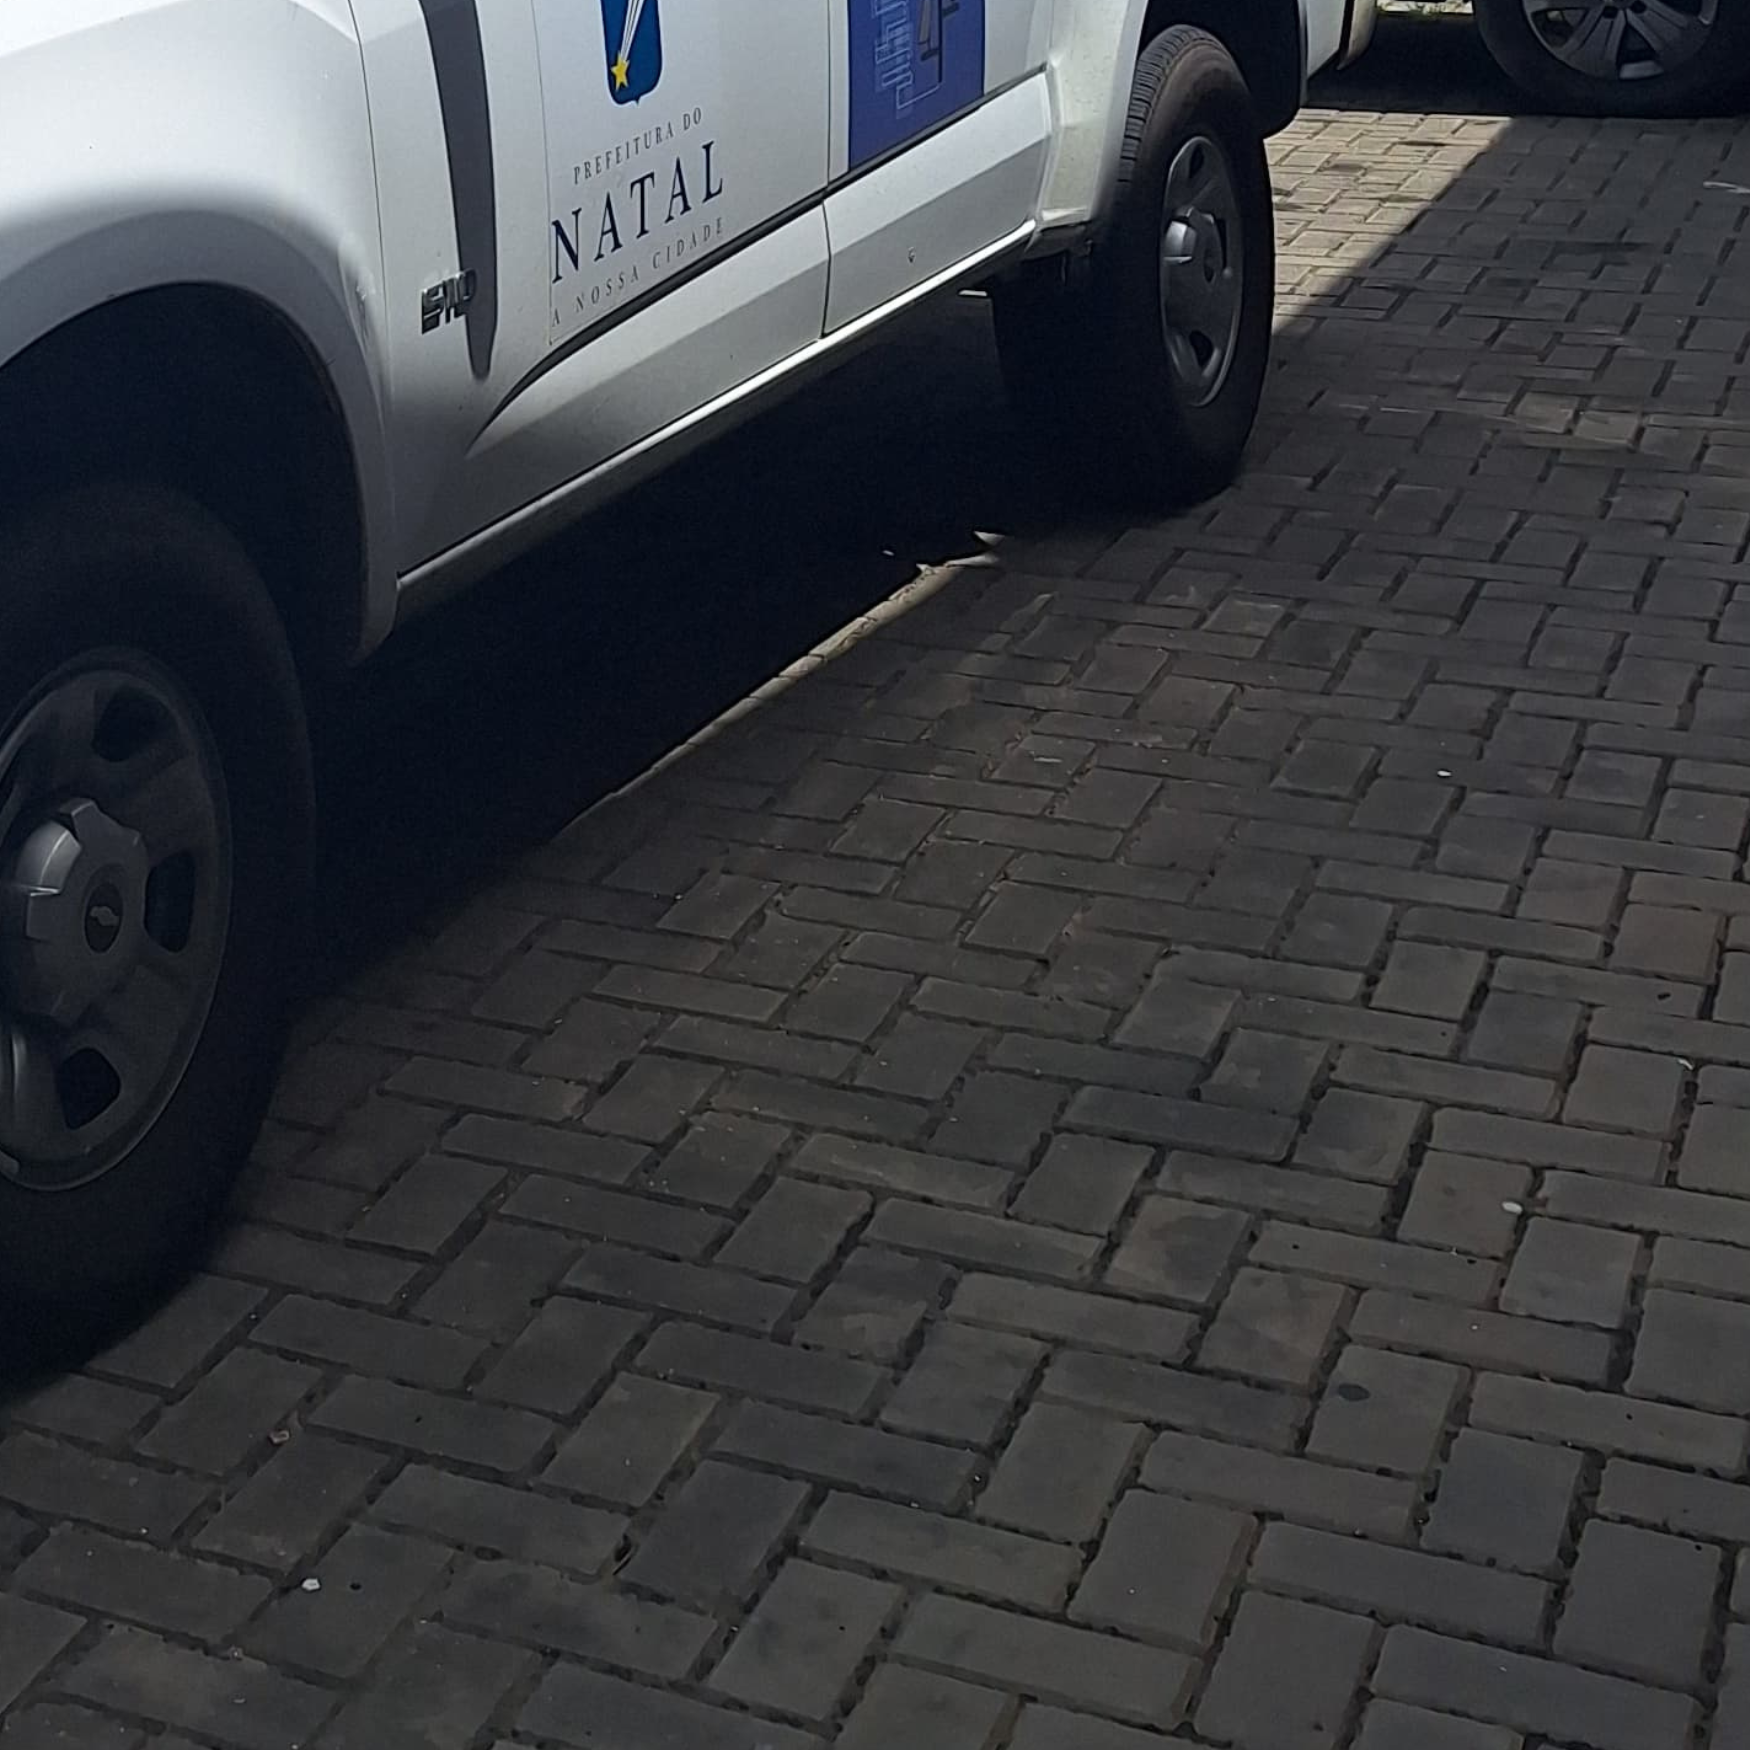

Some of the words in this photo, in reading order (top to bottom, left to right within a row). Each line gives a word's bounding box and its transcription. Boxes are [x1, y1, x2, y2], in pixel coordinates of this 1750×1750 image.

[573, 120, 675, 186] PREFEITURA
[682, 106, 702, 132] DO
[552, 140, 724, 284] NATAL
[551, 308, 561, 328] A
[575, 265, 640, 314] NOSSA
[652, 216, 724, 270] CIDADE
